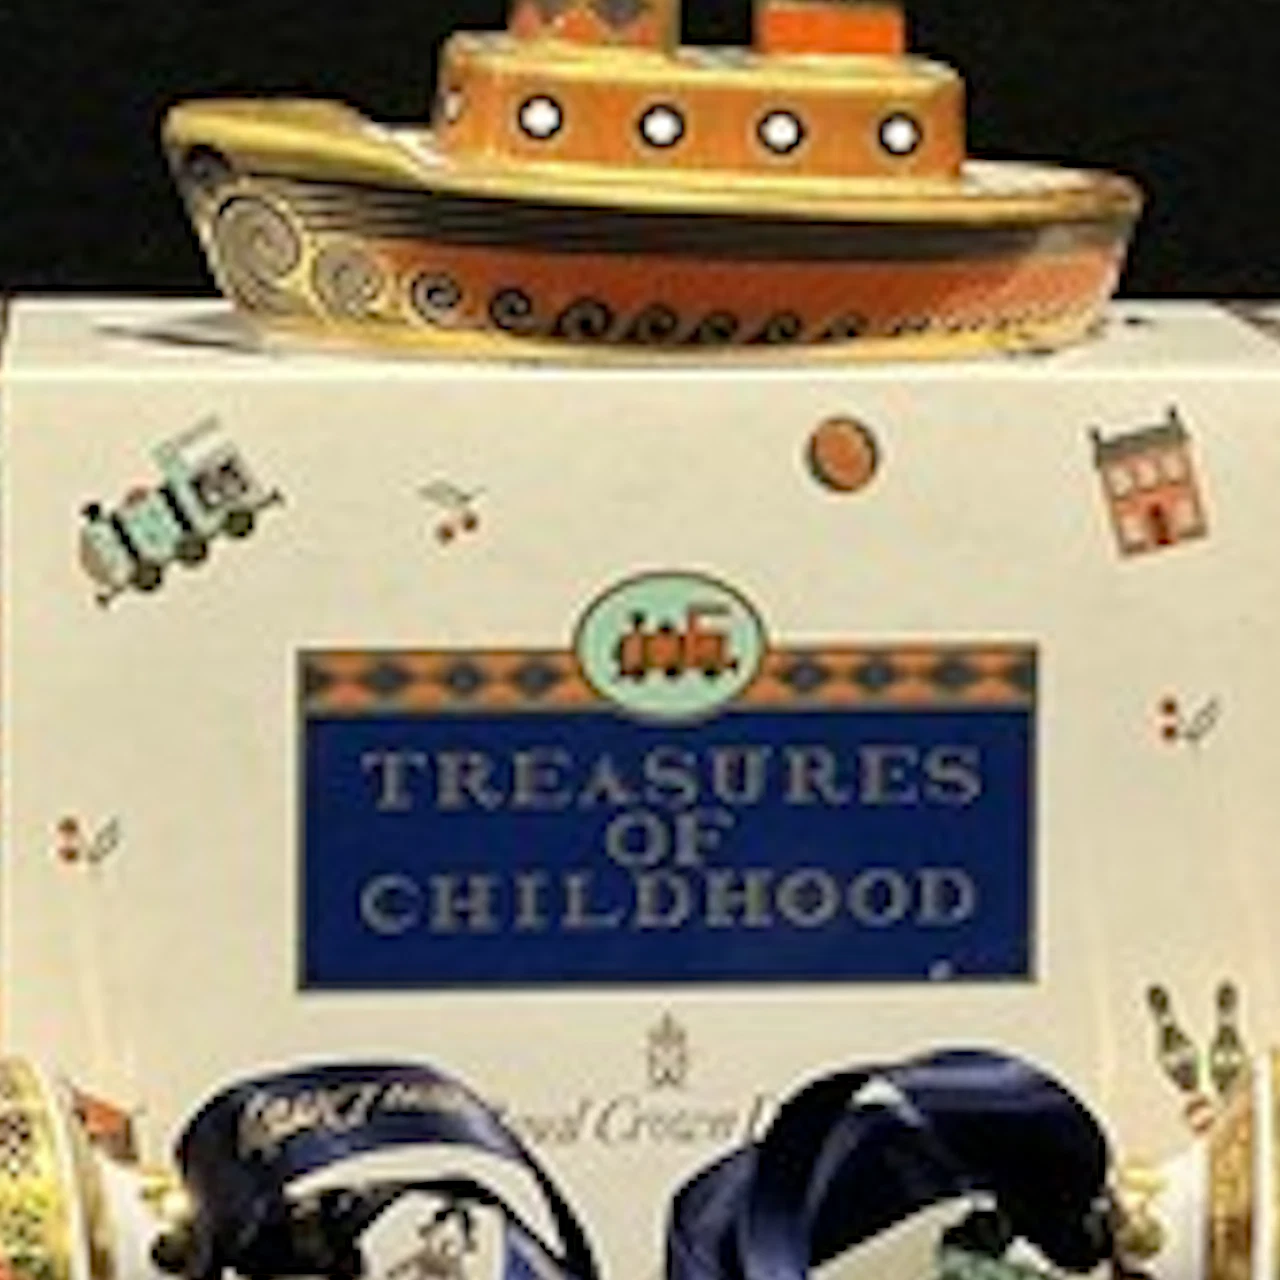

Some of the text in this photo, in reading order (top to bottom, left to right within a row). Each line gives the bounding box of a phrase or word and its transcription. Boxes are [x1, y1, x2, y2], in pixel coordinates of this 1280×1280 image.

[360, 744, 982, 812] TREASURES
[606, 808, 737, 868] OF
[360, 868, 977, 935] CHILDHOOD
